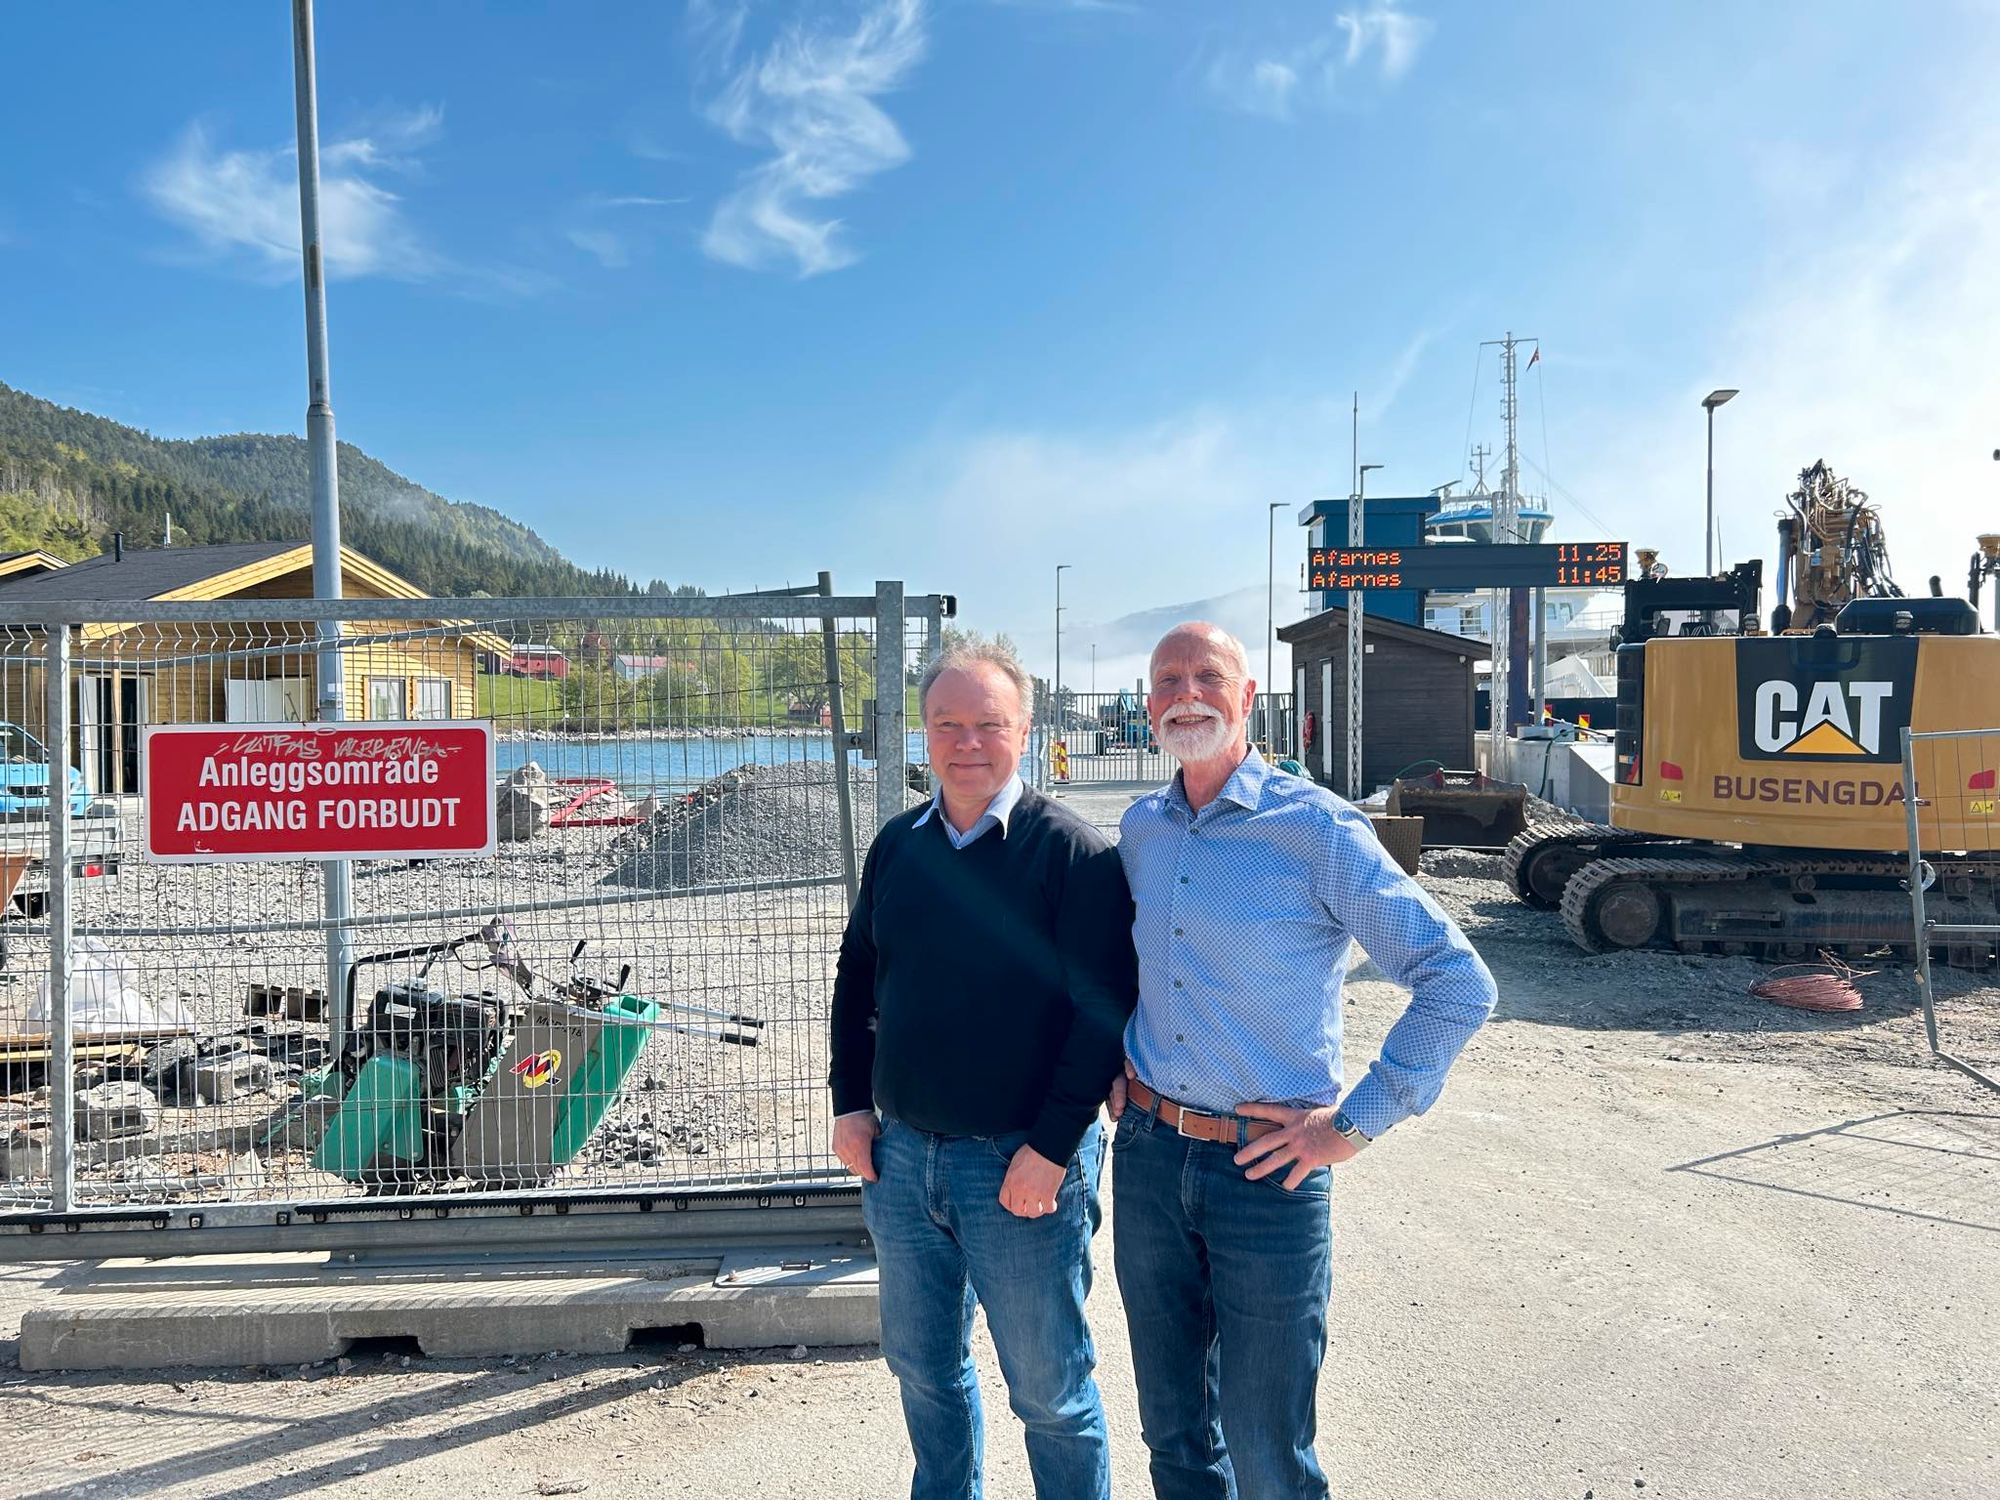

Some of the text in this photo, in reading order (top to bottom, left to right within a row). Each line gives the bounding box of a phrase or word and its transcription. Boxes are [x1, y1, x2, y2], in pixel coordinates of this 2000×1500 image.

[1558, 566, 1621, 584] 11:45
[1755, 680, 1893, 755] CAT
[199, 755, 438, 793] Anleggsområde
[177, 798, 461, 832] ADGANG FORBUDT
